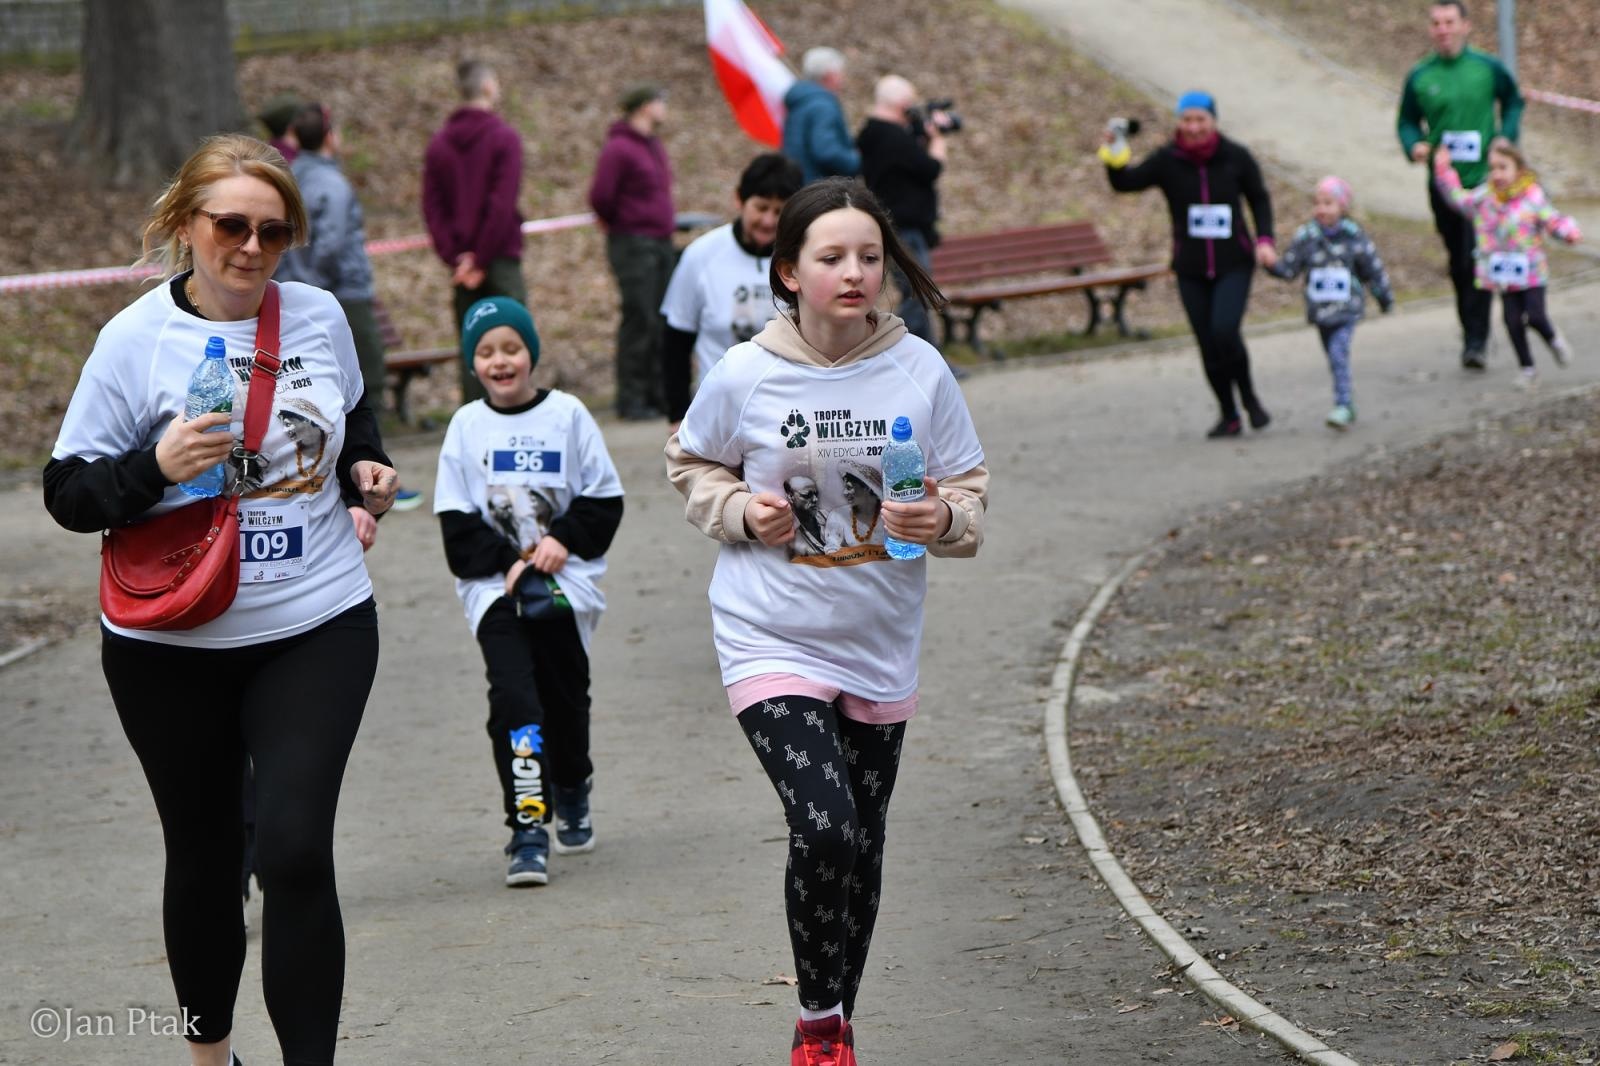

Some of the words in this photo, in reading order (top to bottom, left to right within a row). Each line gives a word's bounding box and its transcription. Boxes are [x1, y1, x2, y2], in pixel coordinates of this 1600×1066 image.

[230, 357, 254, 369] TROP
[291, 377, 313, 390] 2026
[814, 409, 852, 421] TROPEM
[816, 419, 887, 439] WILCZYM
[817, 448, 831, 459] XIV
[833, 446, 865, 458] EDYCJA
[513, 450, 544, 472] 96
[248, 515, 283, 526] WILCZYM
